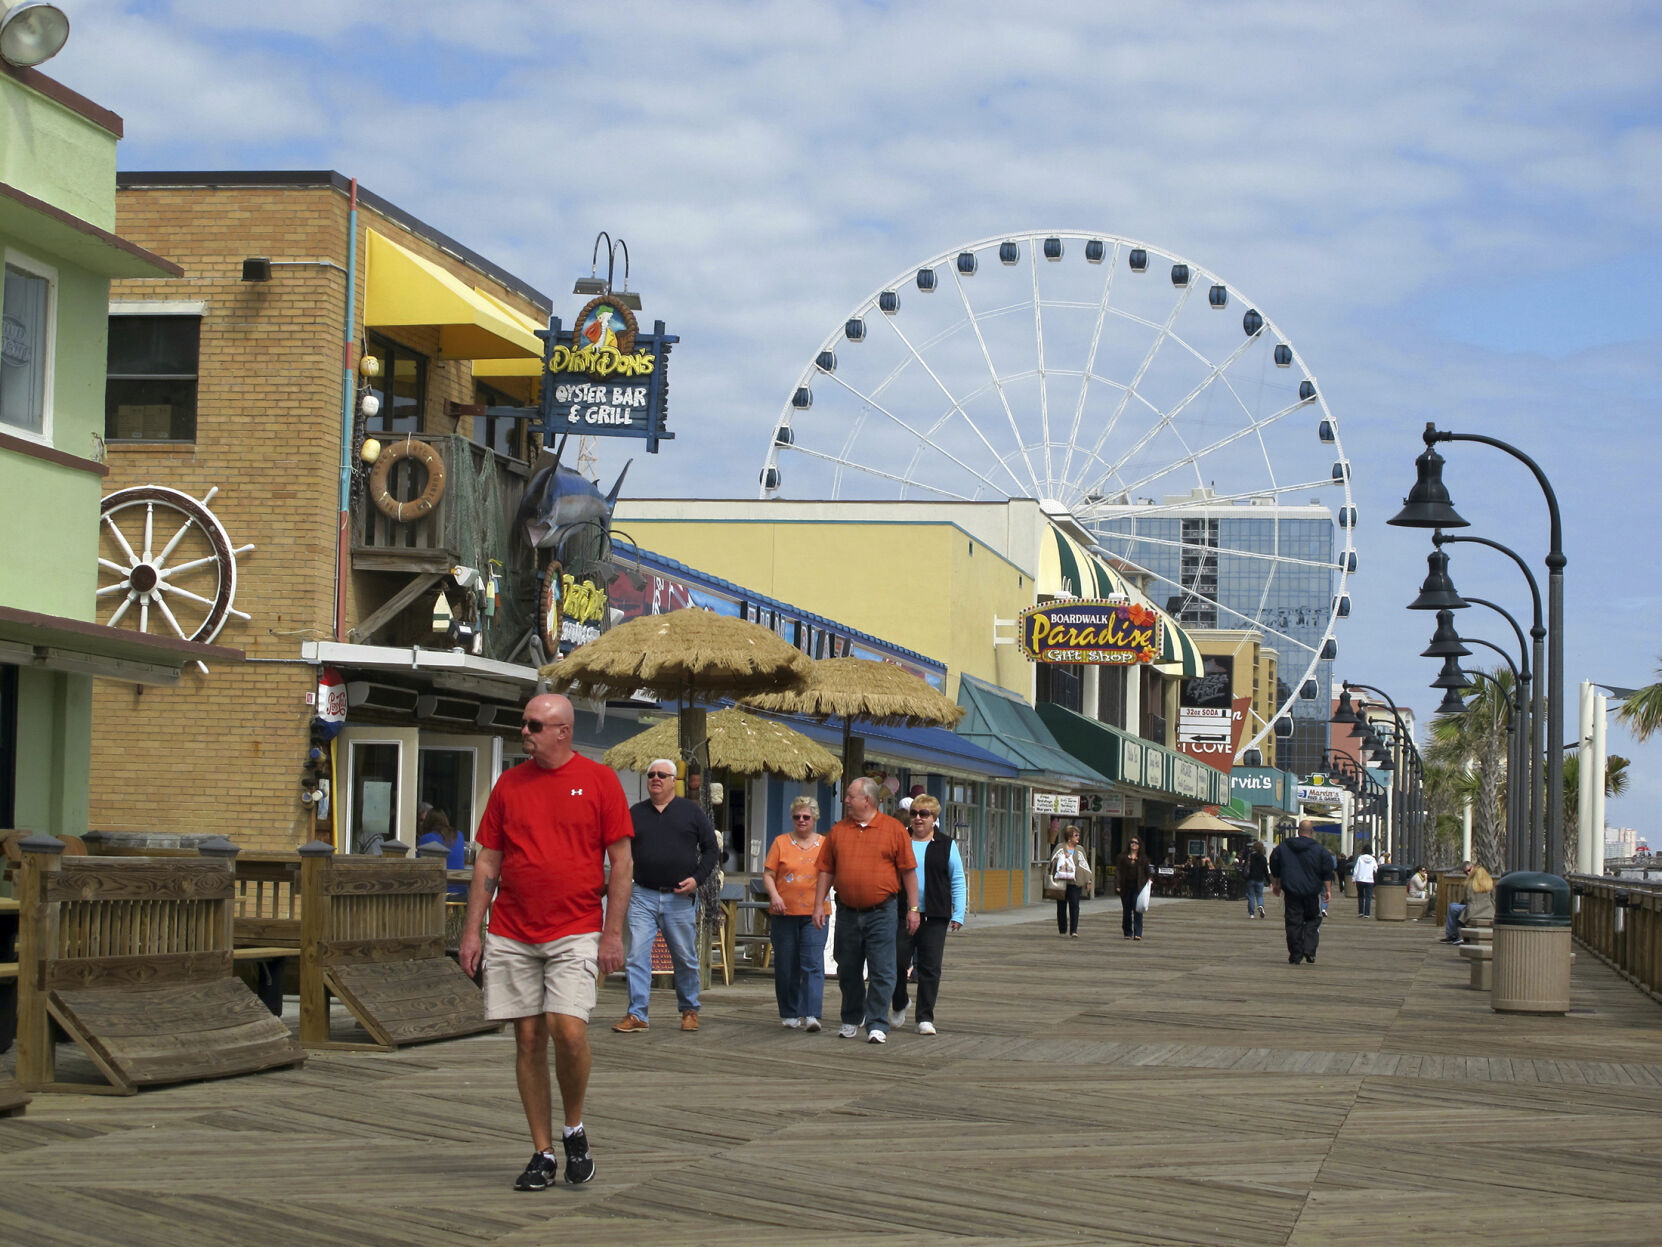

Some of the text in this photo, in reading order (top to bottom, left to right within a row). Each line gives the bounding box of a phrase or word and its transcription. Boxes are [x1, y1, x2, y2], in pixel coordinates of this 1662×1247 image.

[555, 383, 648, 407] OYSTER BAR
[568, 404, 633, 425] & GRILL
[1051, 614, 1108, 624] BOARDWALK
[1032, 611, 1153, 653] Paradise
[1048, 650, 1133, 663] Gift Shop
[1191, 743, 1232, 753] COVE
[1231, 774, 1272, 789] rvin's
